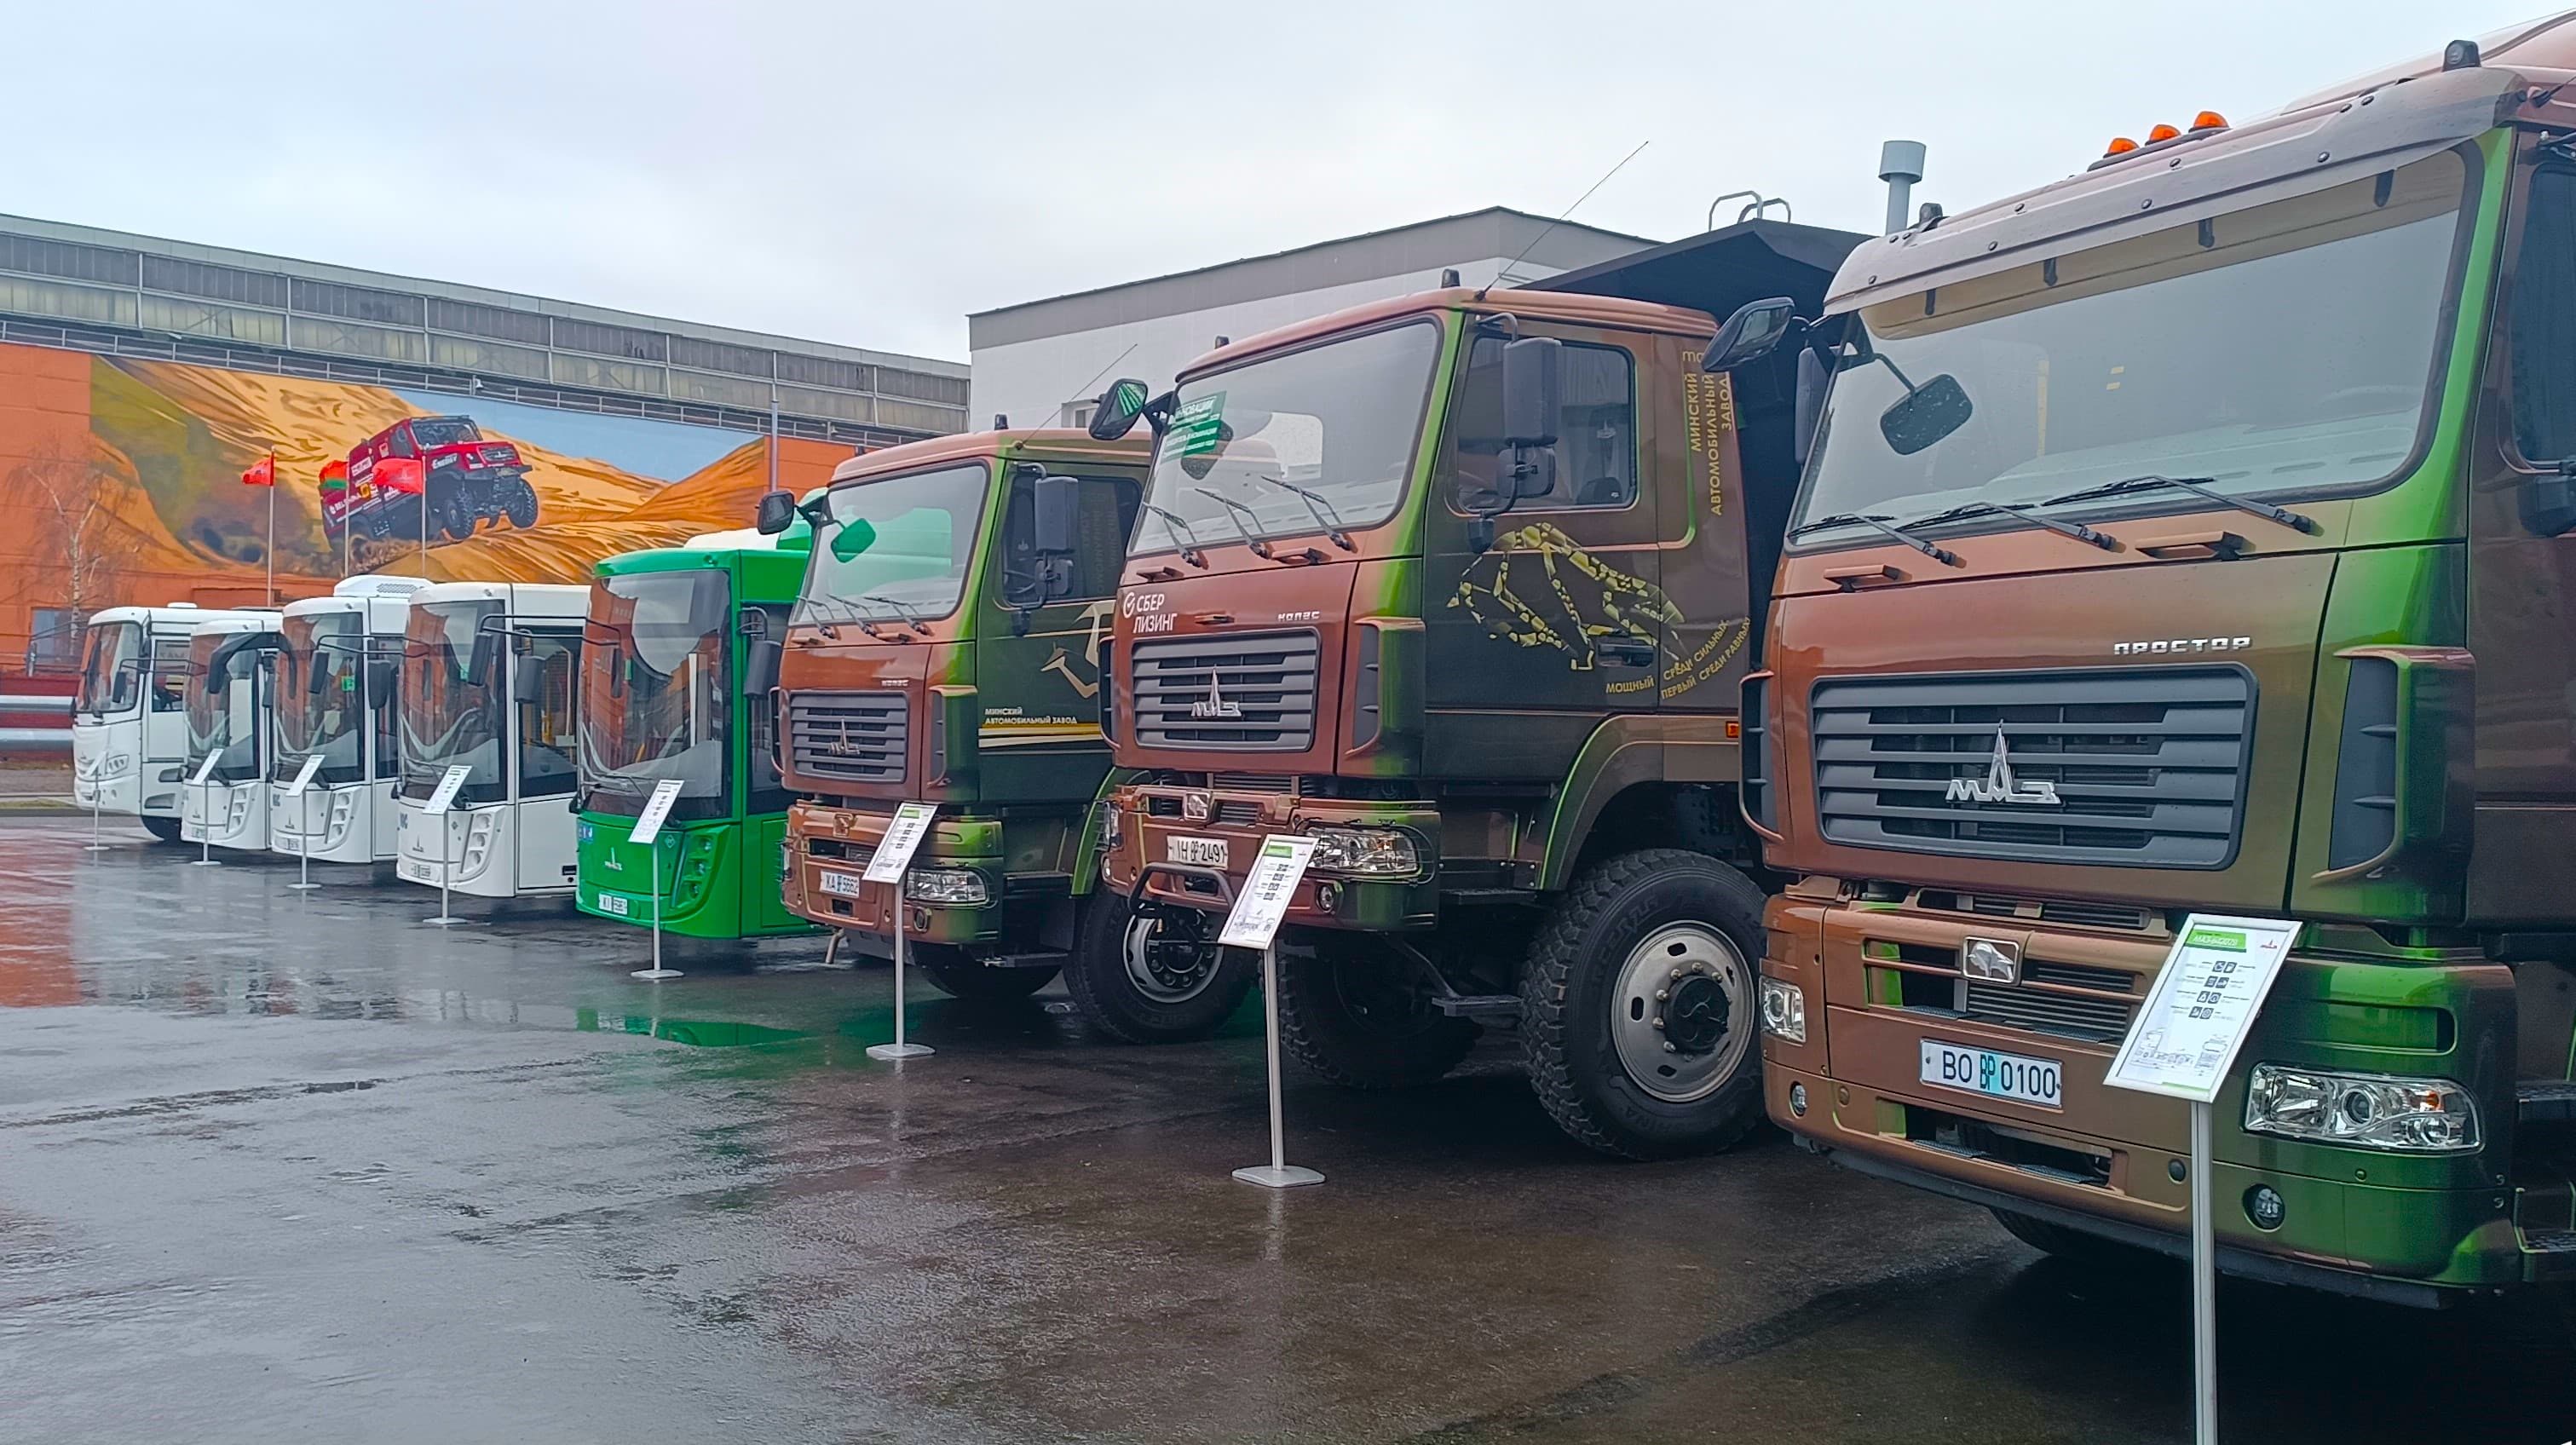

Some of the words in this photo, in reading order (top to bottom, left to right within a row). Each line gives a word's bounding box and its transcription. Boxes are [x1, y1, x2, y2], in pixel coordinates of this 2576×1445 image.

[1684, 372, 1703, 452] МИНСКИЙ
[1719, 376, 1732, 431] ЗАВОД
[1702, 374, 1722, 516] АВТОМОБИЛЬНЫЙ
[1136, 593, 1165, 613] СБЕР
[1132, 613, 1178, 634] ЛИЗИНГ
[1605, 675, 1656, 694] МОЩНЫЙ
[1693, 619, 1730, 662] СИЛЬНЫХ
[2113, 636, 2250, 655] ПРОСТОР
[1661, 675, 1697, 699] ПЕРВЫЙ
[1698, 654, 1726, 681] СРЕДИ
[984, 706, 1023, 716] МИНСКИЙ
[984, 715, 1051, 724] АВТОМОБИЛЬНЫЙ
[1052, 716, 1078, 724] ЗАВОД
[1200, 843, 1225, 864] 2491
[1943, 1051, 1973, 1083] BO
[2001, 1061, 2056, 1098] 0100
